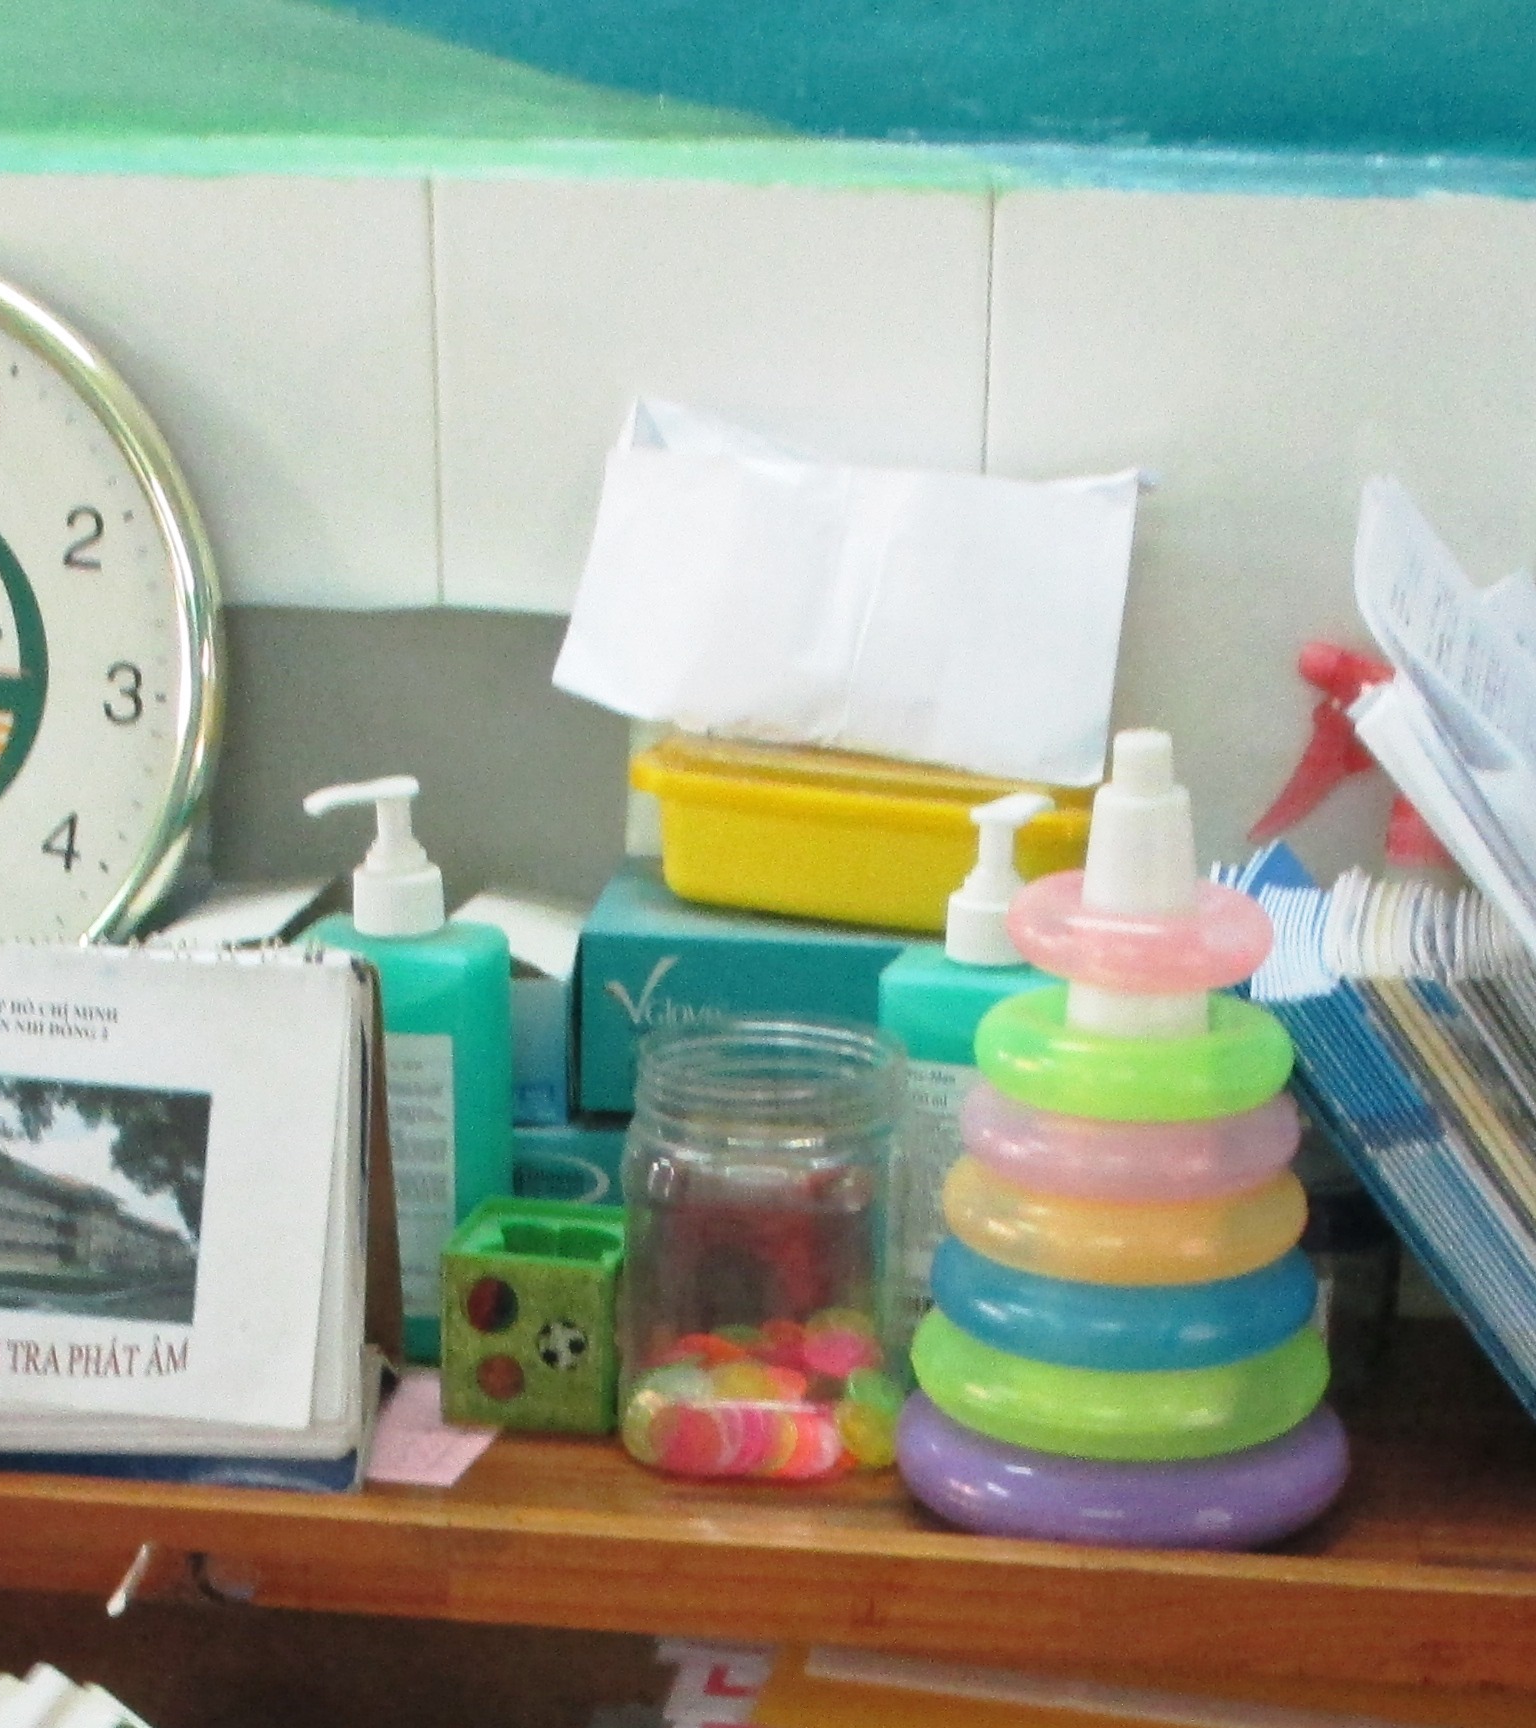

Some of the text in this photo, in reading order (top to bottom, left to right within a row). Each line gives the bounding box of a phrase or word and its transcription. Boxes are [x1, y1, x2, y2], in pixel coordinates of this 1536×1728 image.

[64, 507, 106, 572] 2
[101, 664, 145, 726] 3
[41, 814, 82, 872] 4
[7, 1337, 62, 1377] TRA
[67, 1335, 141, 1378] PHÁT
